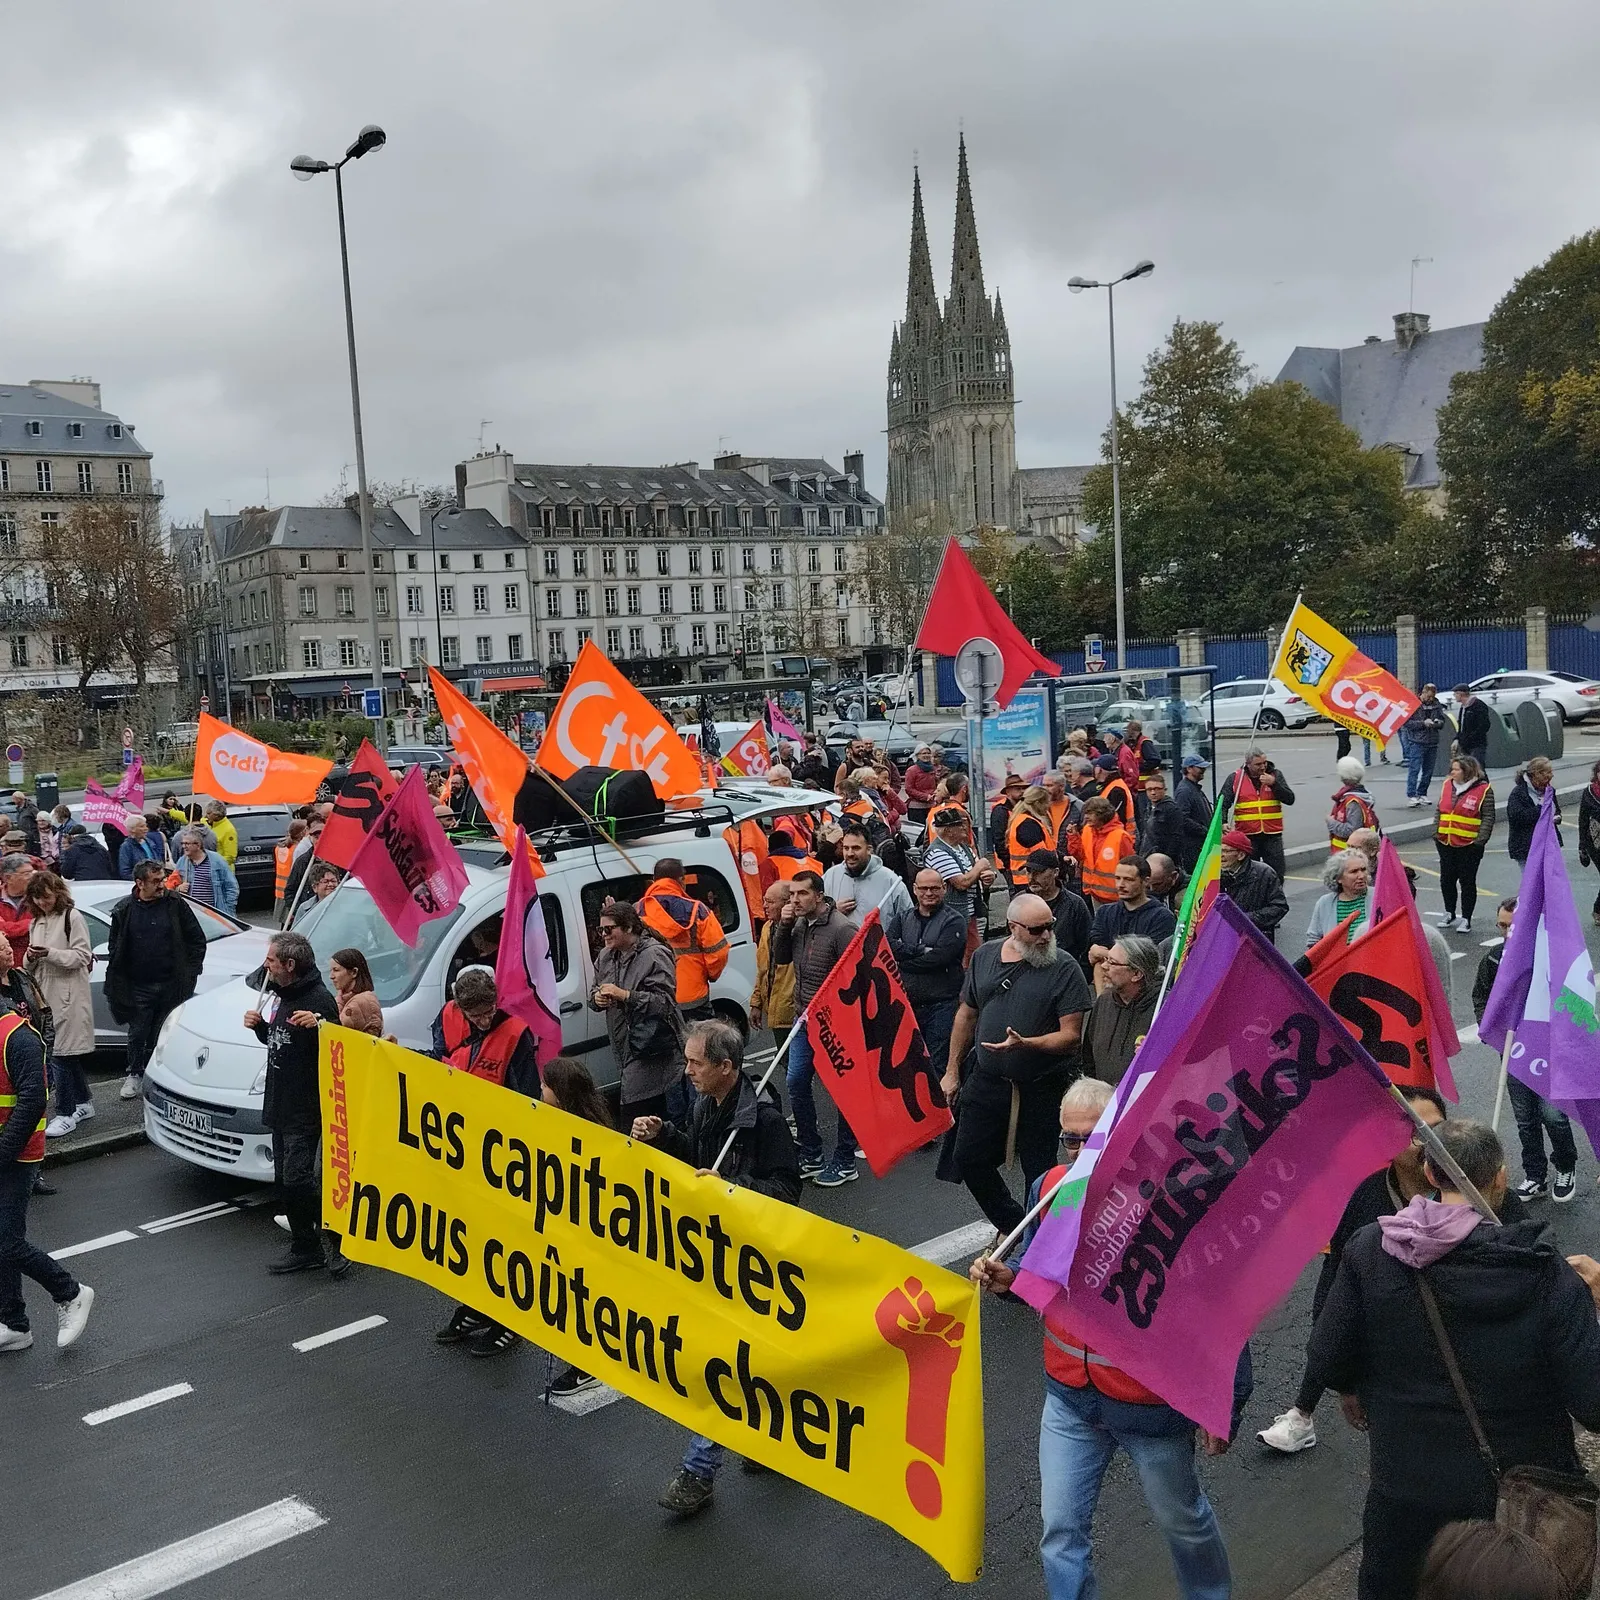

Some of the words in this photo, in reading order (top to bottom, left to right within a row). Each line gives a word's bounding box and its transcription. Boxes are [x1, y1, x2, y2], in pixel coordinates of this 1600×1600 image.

[473, 667, 500, 676] OPTIQUE
[503, 666, 510, 674] LE
[513, 665, 534, 673] BIHAN
[1331, 679, 1410, 737] cgt
[329, 1039, 351, 1213] Solidaires
[397, 1071, 466, 1171] Les
[481, 1128, 808, 1332] capitalistes
[348, 1181, 470, 1278] nous
[483, 1238, 689, 1399] coûtent
[704, 1339, 865, 1474] cher
